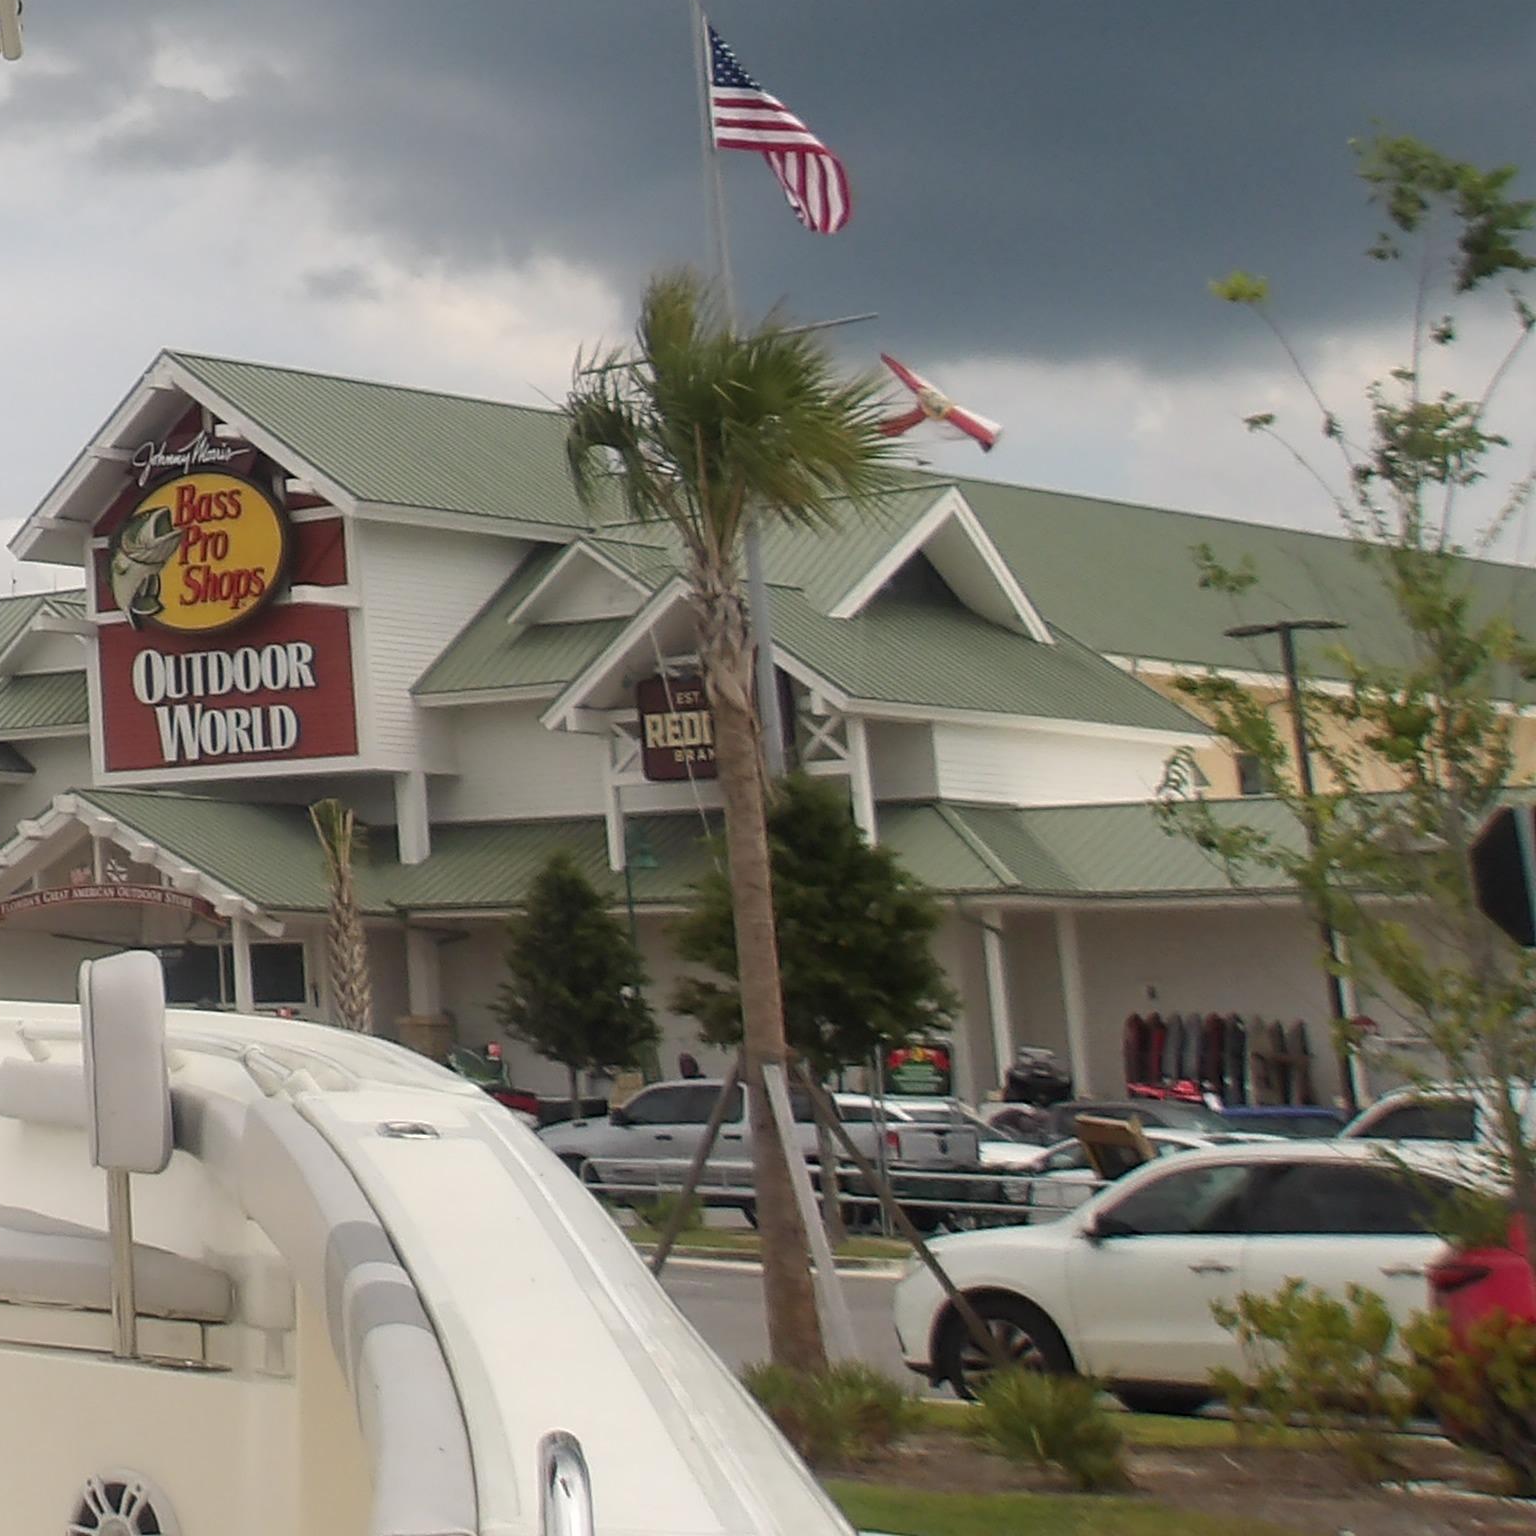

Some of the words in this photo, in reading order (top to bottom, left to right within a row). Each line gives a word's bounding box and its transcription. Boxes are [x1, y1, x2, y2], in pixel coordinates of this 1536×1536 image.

[173, 483, 243, 528] Bass
[178, 525, 230, 566] Pro
[179, 565, 267, 610] Shops
[132, 642, 317, 704] OUTDOOR
[155, 703, 298, 763] WORLD
[117, 887, 161, 901] OUTDOOR
